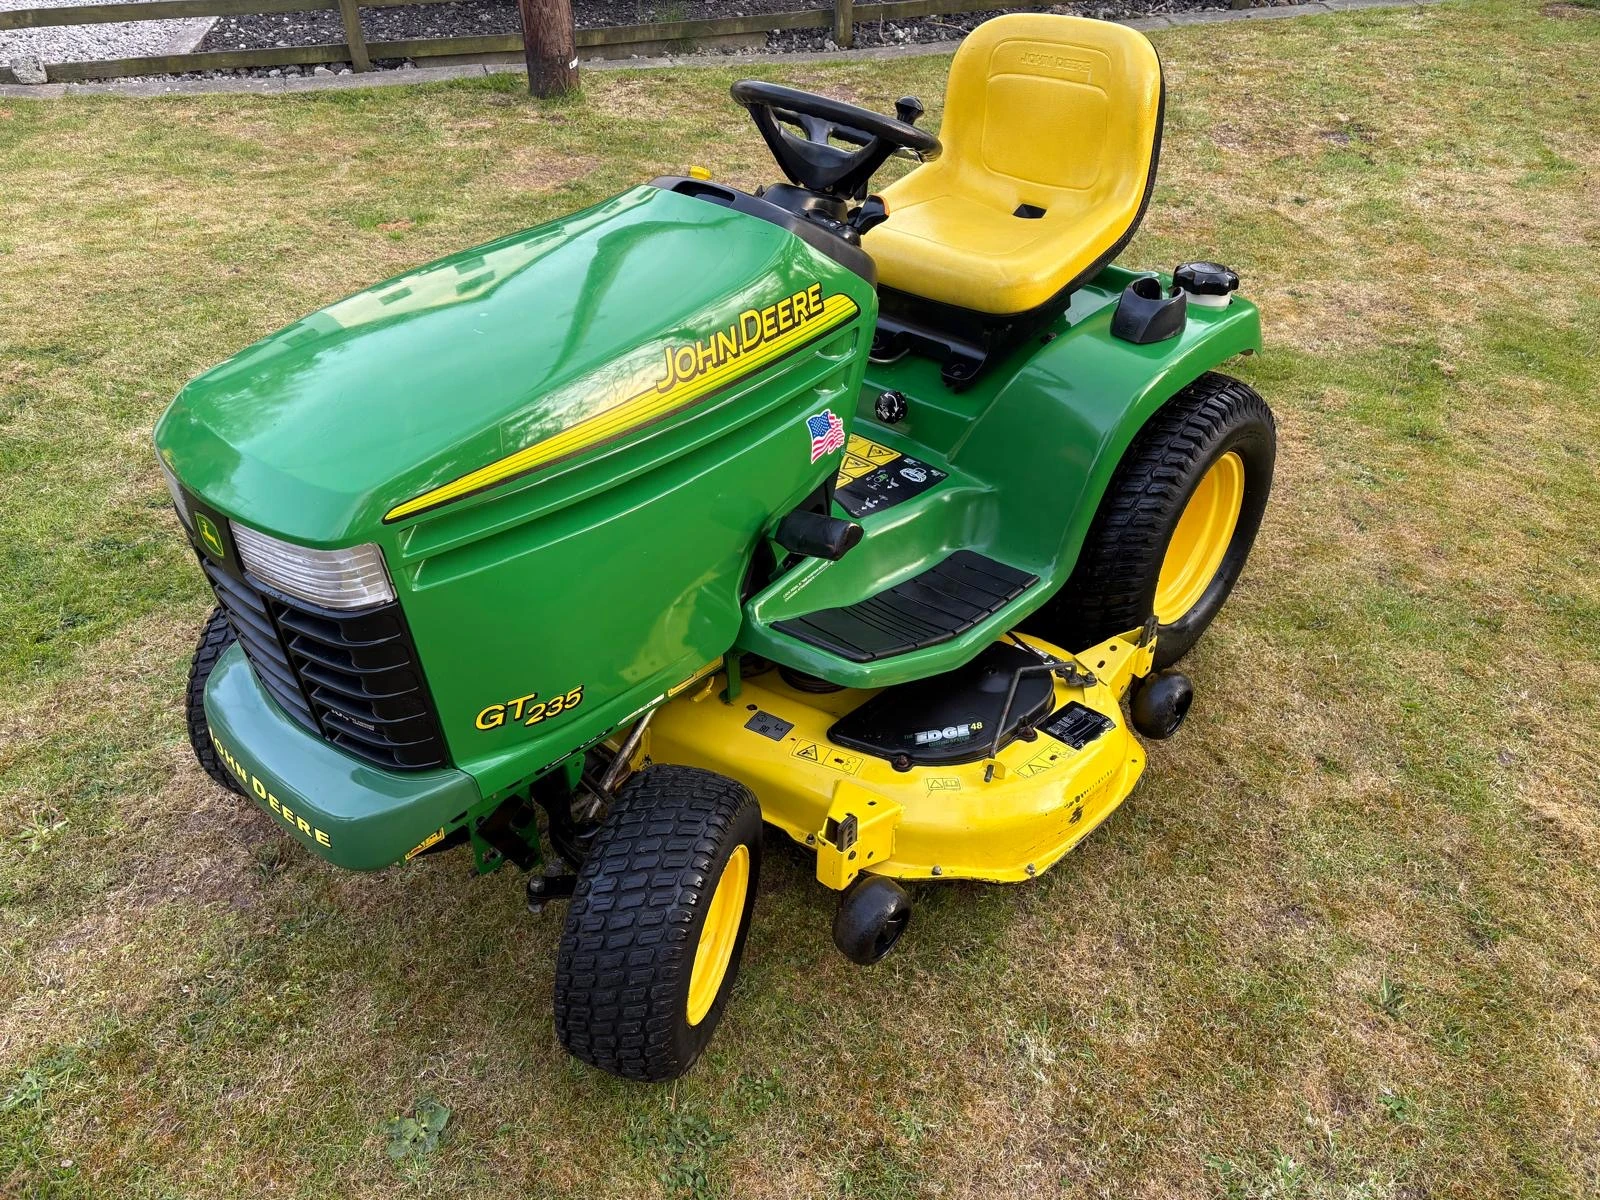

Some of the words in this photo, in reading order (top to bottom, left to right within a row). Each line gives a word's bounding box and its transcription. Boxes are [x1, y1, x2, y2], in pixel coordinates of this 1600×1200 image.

[656, 324, 741, 393] JOHN
[739, 281, 824, 354] DEERE
[914, 723, 970, 745] EDGE
[970, 721, 983, 730] 48
[251, 774, 332, 848] DEERE
